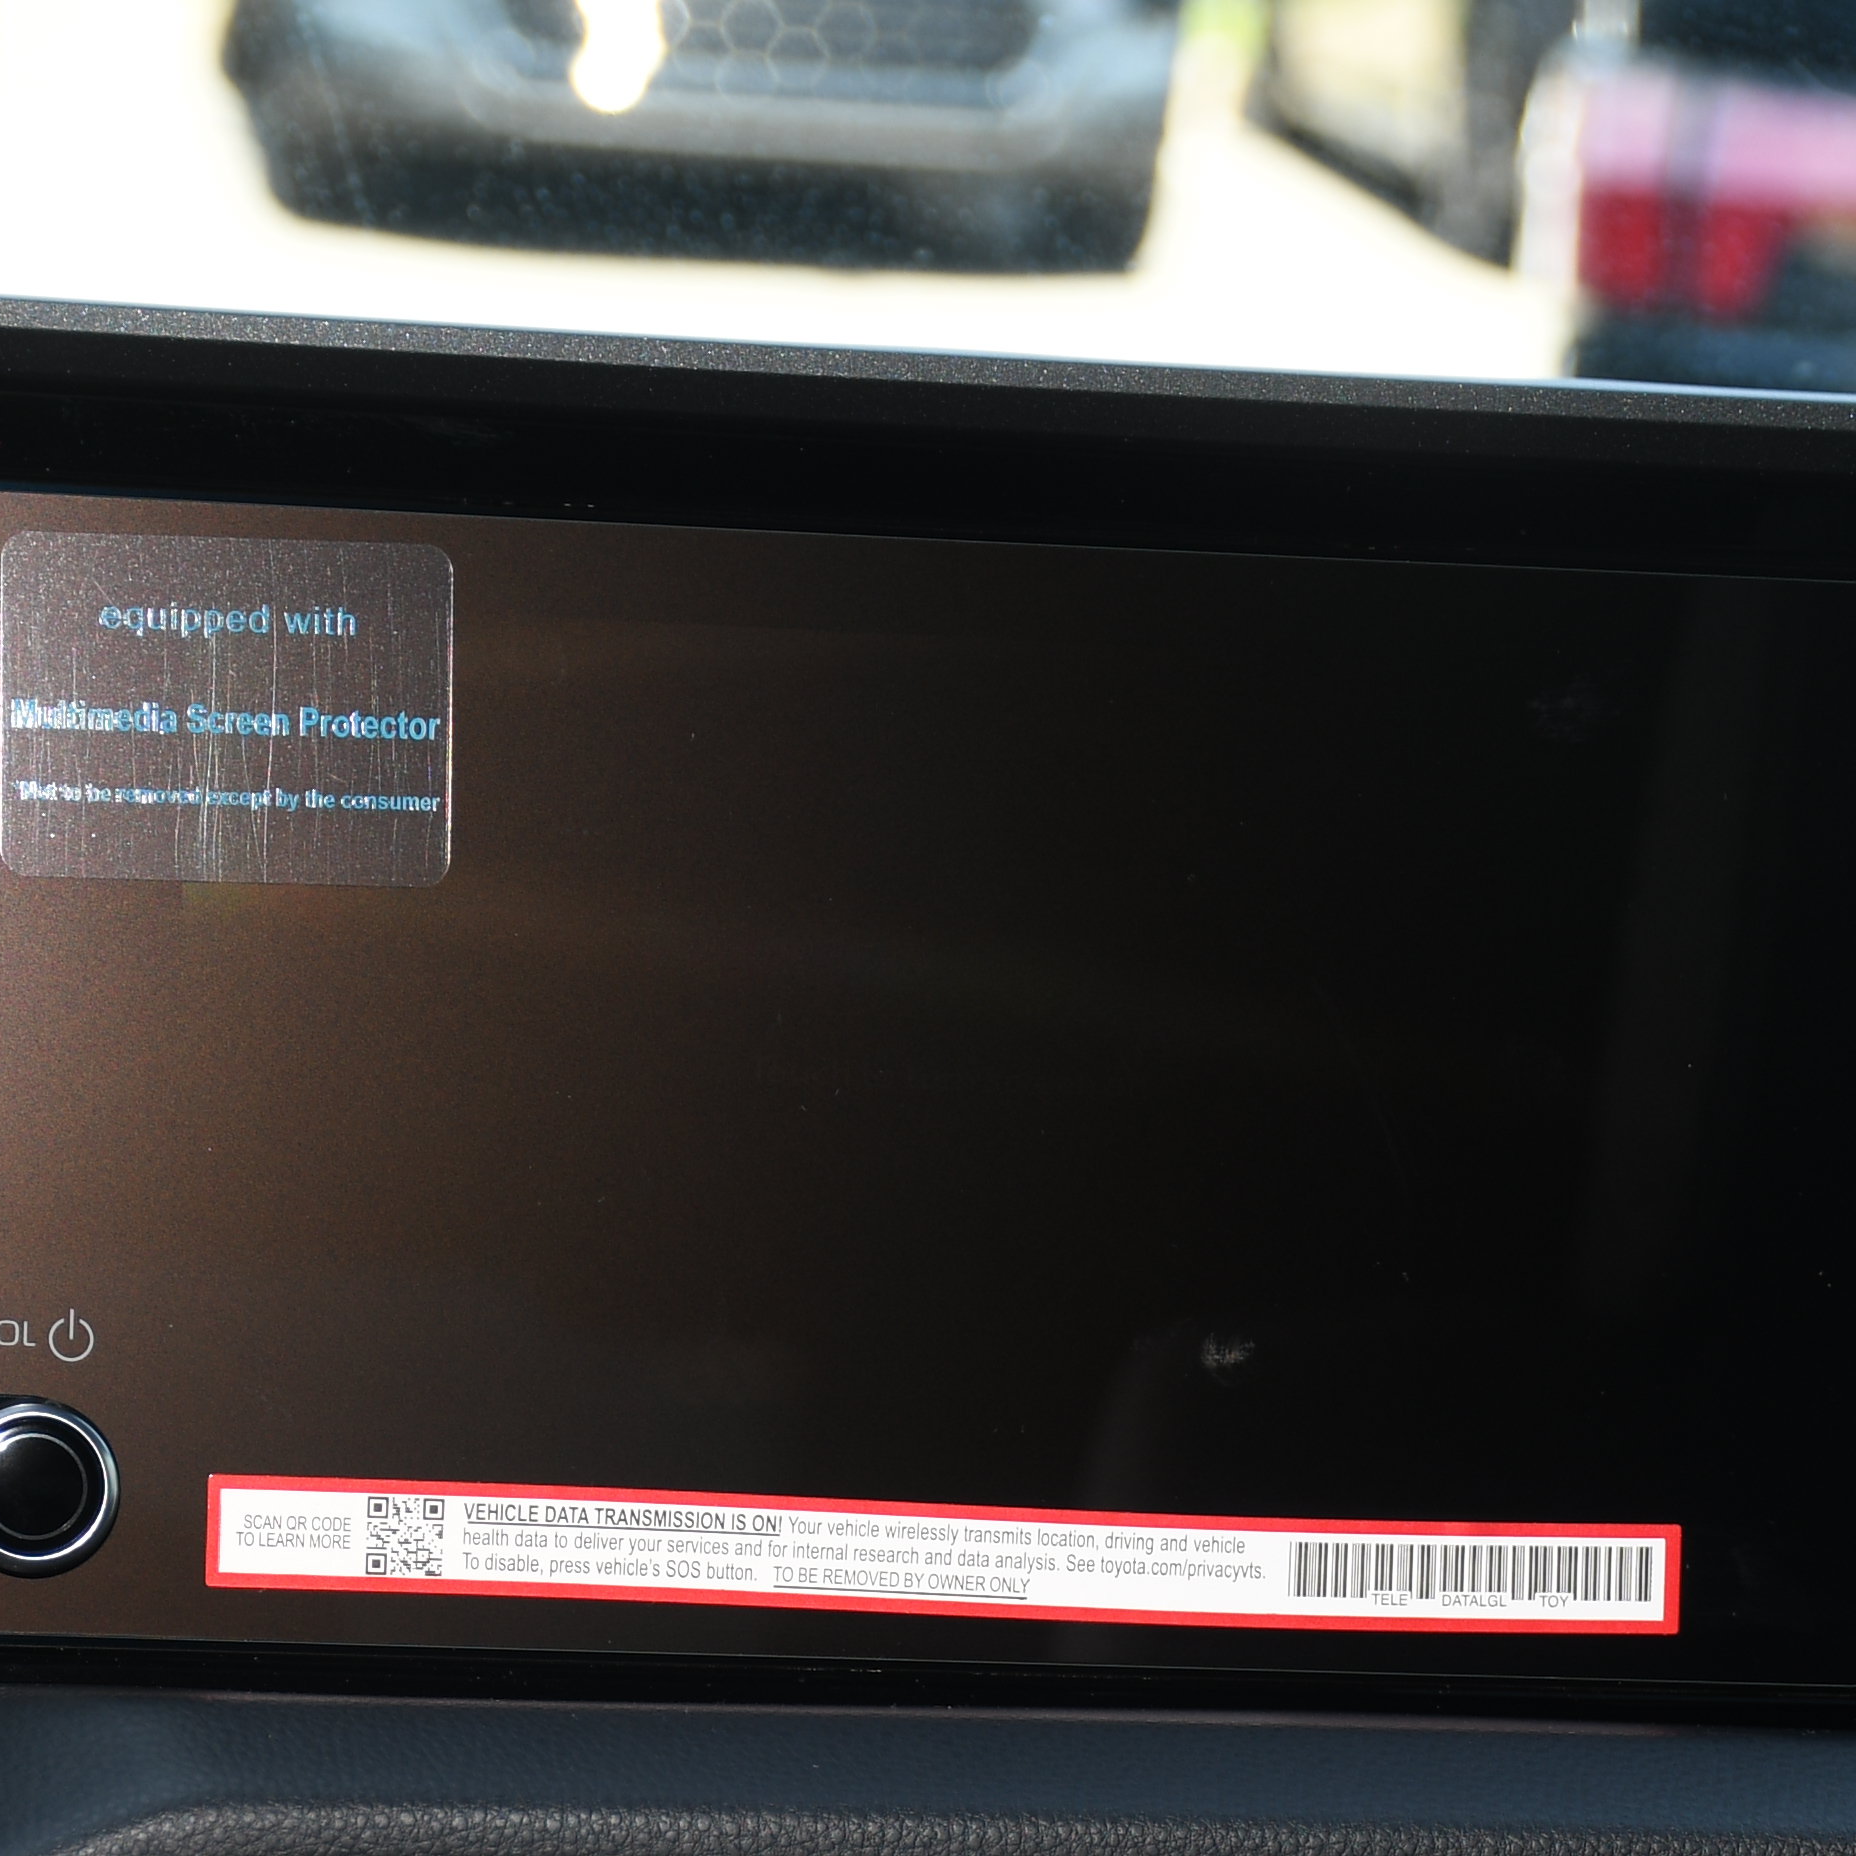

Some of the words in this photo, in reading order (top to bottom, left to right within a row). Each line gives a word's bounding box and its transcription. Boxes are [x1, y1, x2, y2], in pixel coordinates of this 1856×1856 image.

[98, 601, 270, 639] equipped
[283, 606, 359, 636] with
[10, 697, 178, 734] Multimedia
[186, 703, 290, 737] Screen
[299, 706, 441, 741] Protector
[85, 782, 112, 803] be
[115, 786, 203, 805] removed
[206, 790, 271, 811] except
[276, 787, 300, 812] by
[305, 789, 336, 809] the
[341, 795, 441, 812] consumer
[236, 1531, 255, 1546] TO
[259, 1532, 305, 1548] LEARN
[309, 1534, 351, 1549] MORE
[244, 1514, 282, 1530] SCAN
[286, 1516, 307, 1530] QR
[311, 1517, 351, 1532] CODE
[464, 1502, 539, 1522] VEHICLE
[545, 1505, 589, 1524] DATA
[594, 1507, 725, 1530] TRANSMISSION
[732, 1513, 746, 1531] IS
[752, 1514, 782, 1533] ON!
[789, 1516, 822, 1535] Your
[827, 1519, 880, 1538] vehicle
[885, 1520, 959, 1546] wirelessly
[964, 1525, 1031, 1546] transmits
[1037, 1528, 1099, 1550] location,
[1105, 1532, 1154, 1555] driving
[1160, 1534, 1187, 1552] and
[1193, 1536, 1245, 1554] vehicle
[462, 1552, 479, 1570] To
[484, 1553, 543, 1576] disable,
[549, 1558, 590, 1577] press
[596, 1557, 660, 1577] vehicle's
[666, 1560, 701, 1579] SOS
[707, 1562, 758, 1581] button.
[773, 1565, 794, 1583] TO
[798, 1567, 818, 1584] BE
[823, 1568, 900, 1587] REMOVED
[904, 1572, 924, 1588] BY
[928, 1573, 986, 1591] OWNER
[989, 1576, 1030, 1594] ONLY
[463, 1527, 509, 1547] health
[514, 1529, 548, 1548] data
[554, 1532, 568, 1549] to
[574, 1532, 624, 1551] deliver
[629, 1537, 662, 1556] your
[667, 1536, 729, 1555] services
[734, 1539, 762, 1557] and
[767, 1539, 788, 1558] for
[792, 1541, 848, 1561] internal
[853, 1546, 919, 1565] research
[924, 1548, 952, 1566] and
[957, 1549, 989, 1568] data
[995, 1551, 1060, 1575] analysis.
[1066, 1553, 1095, 1573] See
[1100, 1556, 1266, 1583] toyota.com/privacyvts.
[1371, 1593, 1408, 1606] TELE
[1441, 1593, 1507, 1608] DATALGL
[1539, 1594, 1569, 1608] TOY
